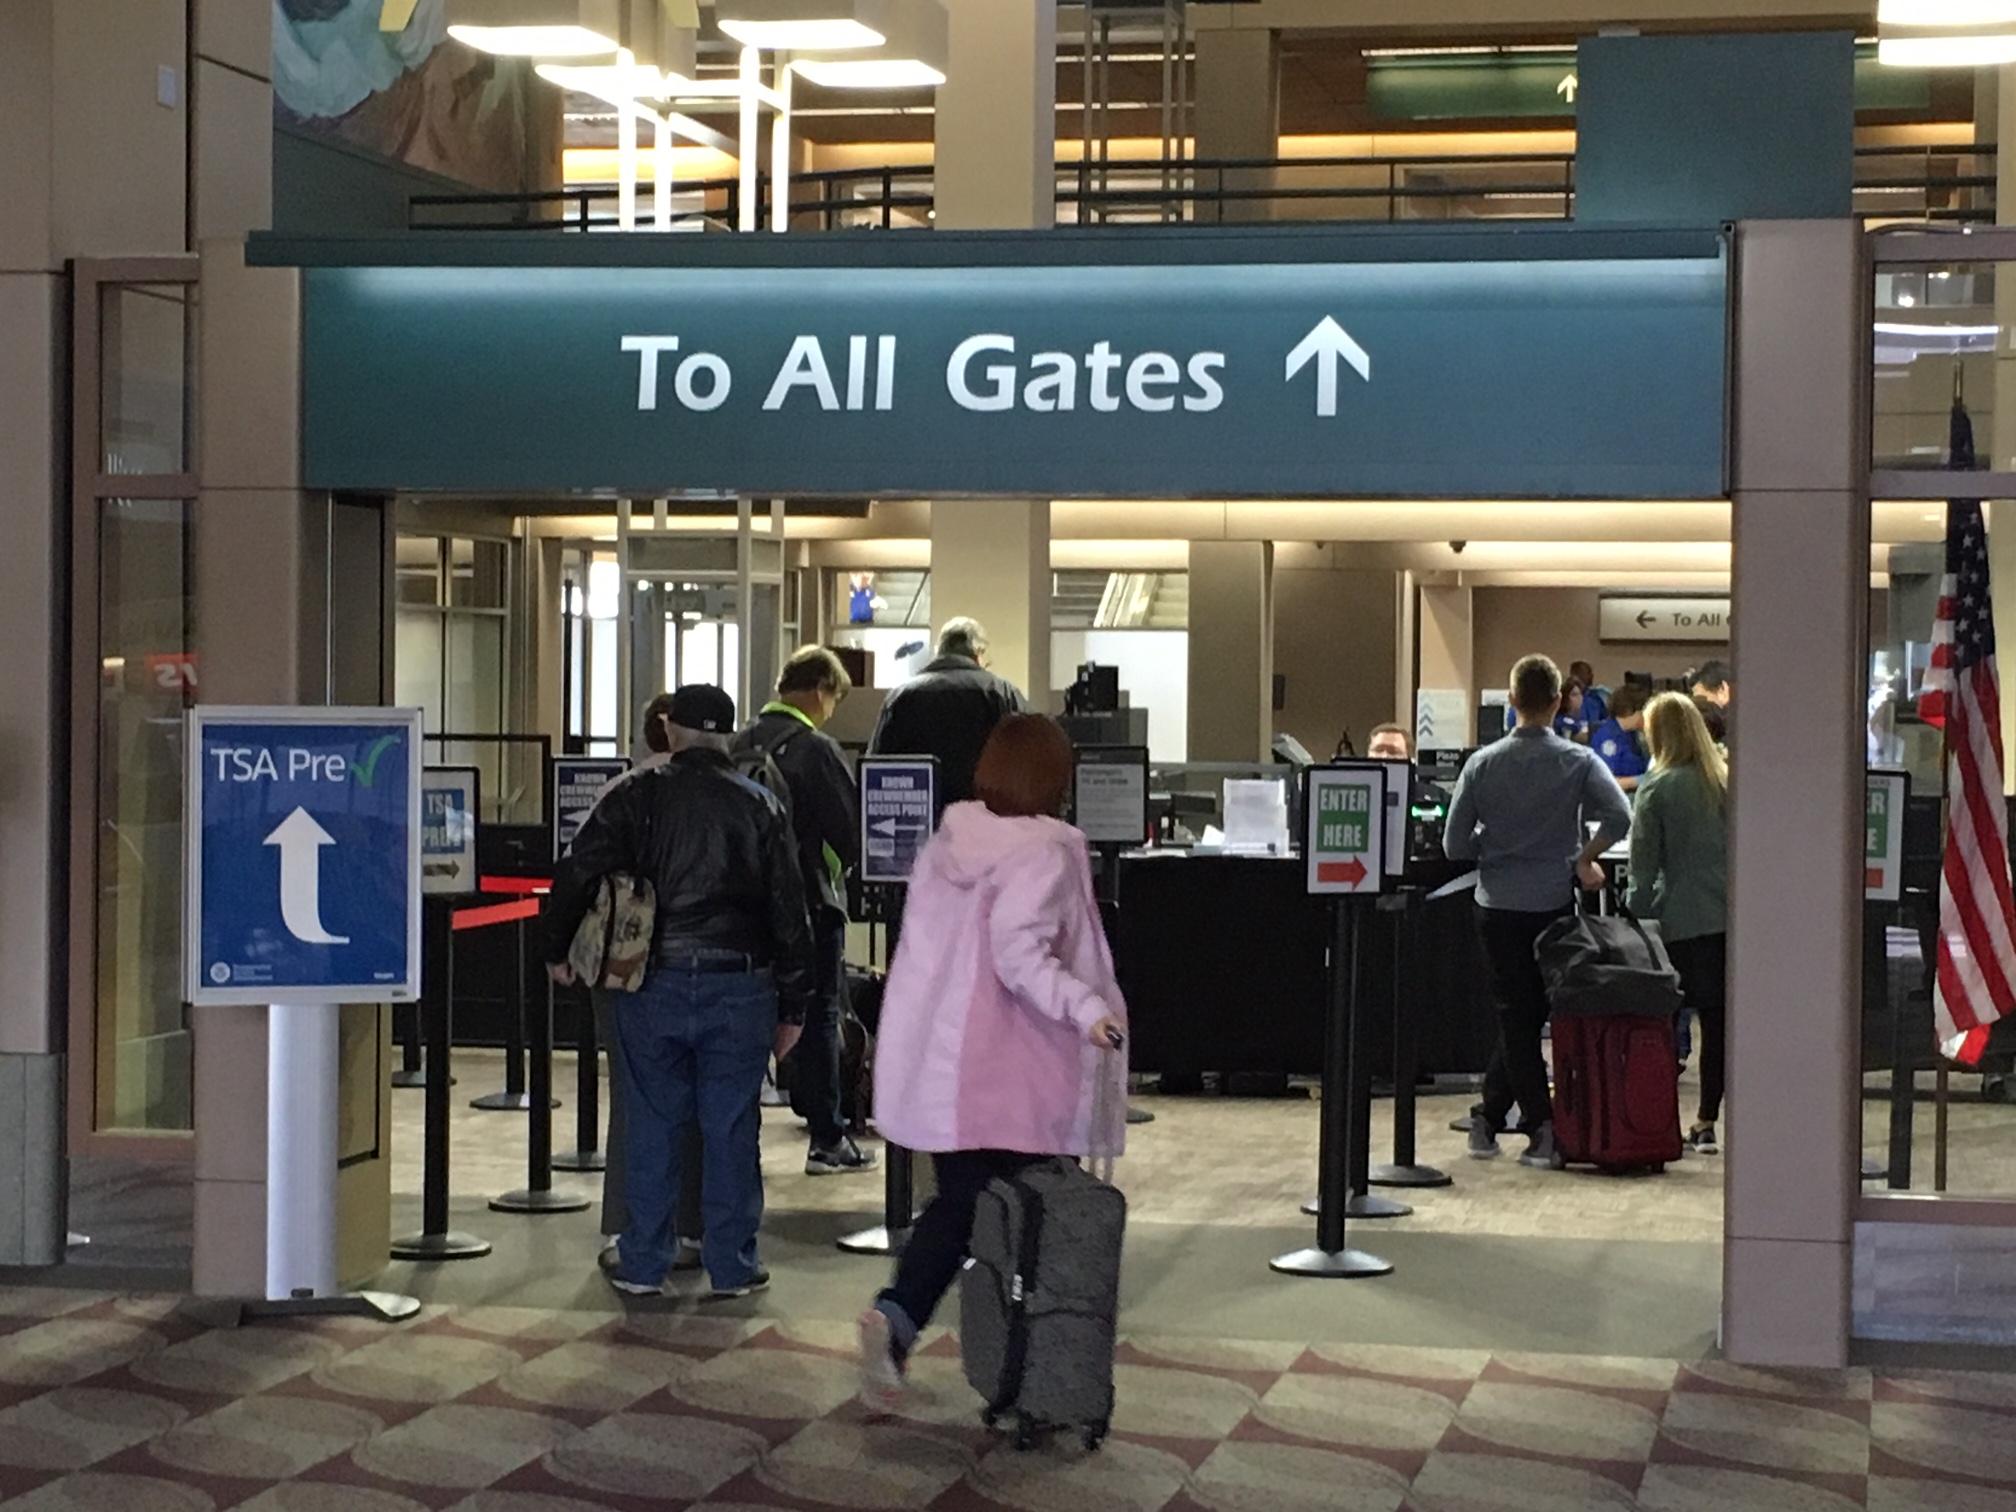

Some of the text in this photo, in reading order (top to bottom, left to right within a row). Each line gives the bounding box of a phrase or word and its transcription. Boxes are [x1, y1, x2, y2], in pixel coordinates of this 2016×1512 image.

[620, 333, 1226, 413] To All Gates
[1672, 612, 1692, 627] To
[1697, 612, 1721, 627] All
[210, 748, 346, 782] TSA Pre
[1320, 788, 1368, 812] ENTER
[1323, 824, 1362, 848] HERE
